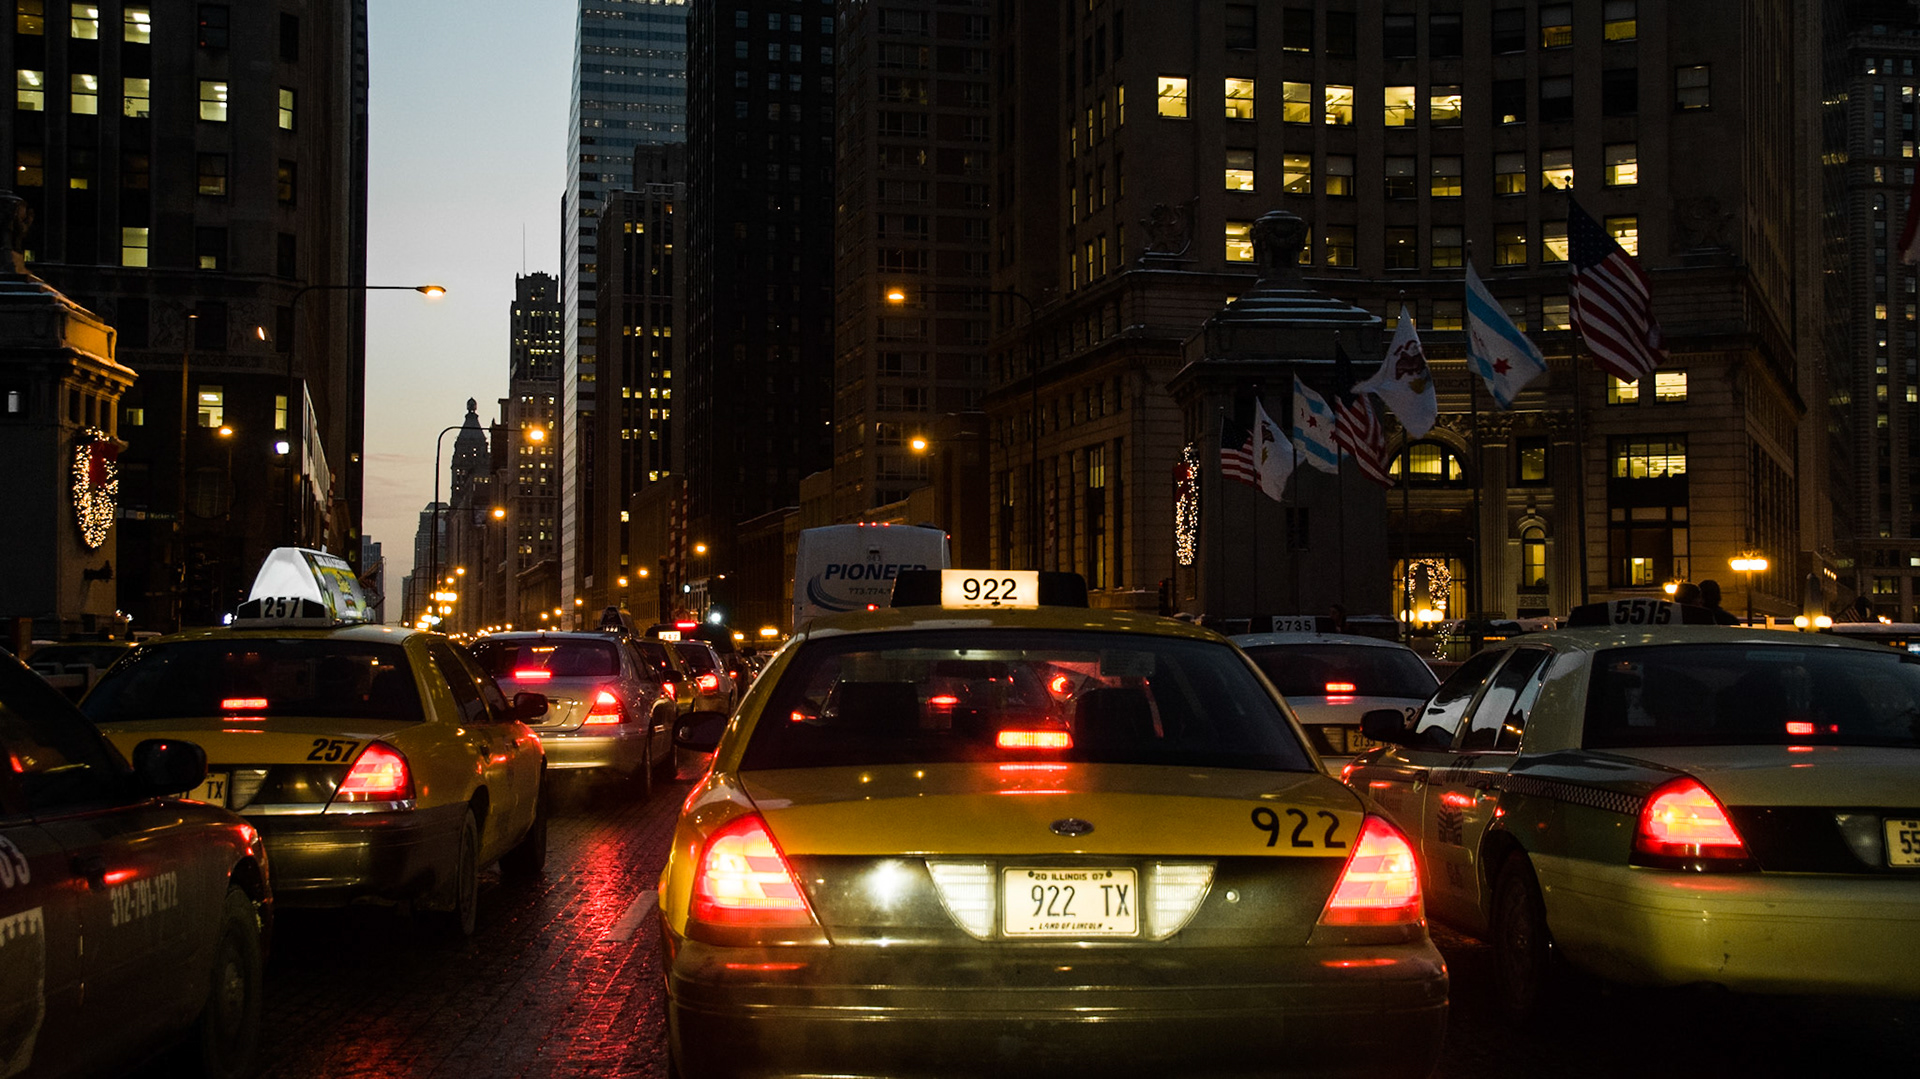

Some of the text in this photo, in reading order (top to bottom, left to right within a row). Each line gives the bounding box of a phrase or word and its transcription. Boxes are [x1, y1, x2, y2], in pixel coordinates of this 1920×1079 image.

[963, 577, 1018, 601] 922
[264, 597, 300, 618] 257
[1614, 600, 1672, 625] 5515
[1275, 620, 1312, 631] 2735
[307, 738, 360, 762] 257
[207, 781, 224, 799] TX
[1251, 807, 1347, 848] 922
[1034, 873, 1048, 881] 20
[1051, 873, 1088, 881] ILLINOIS
[110, 870, 179, 928] 312-791-1272
[1031, 884, 1130, 917] 922 TX
